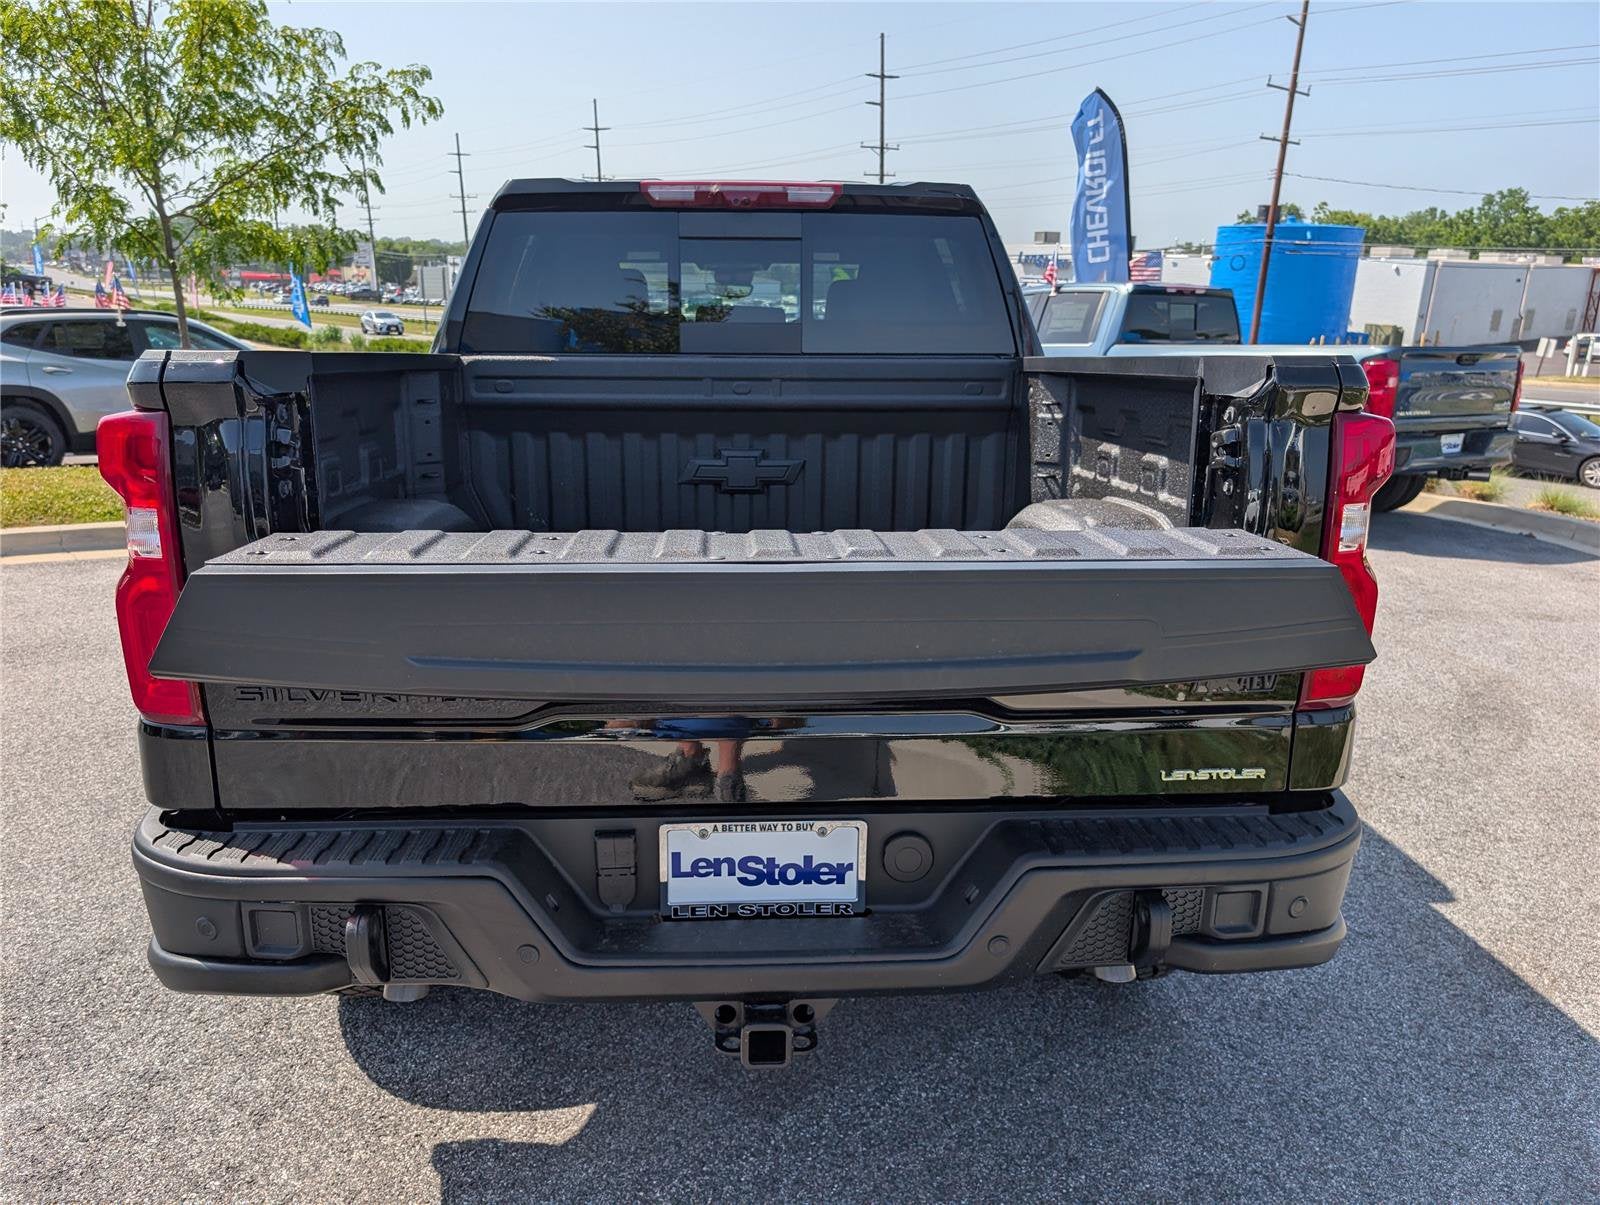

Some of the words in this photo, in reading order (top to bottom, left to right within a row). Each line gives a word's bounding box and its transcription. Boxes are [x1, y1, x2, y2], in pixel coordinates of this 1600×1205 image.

[234, 686, 497, 702] SILVER
[712, 824, 719, 833] A
[721, 824, 757, 833] BETTER
[759, 823, 779, 832] WAY
[780, 823, 794, 832] TO
[795, 823, 815, 831] BUY
[671, 904, 729, 919] LEN
[737, 902, 854, 917] STOLER
